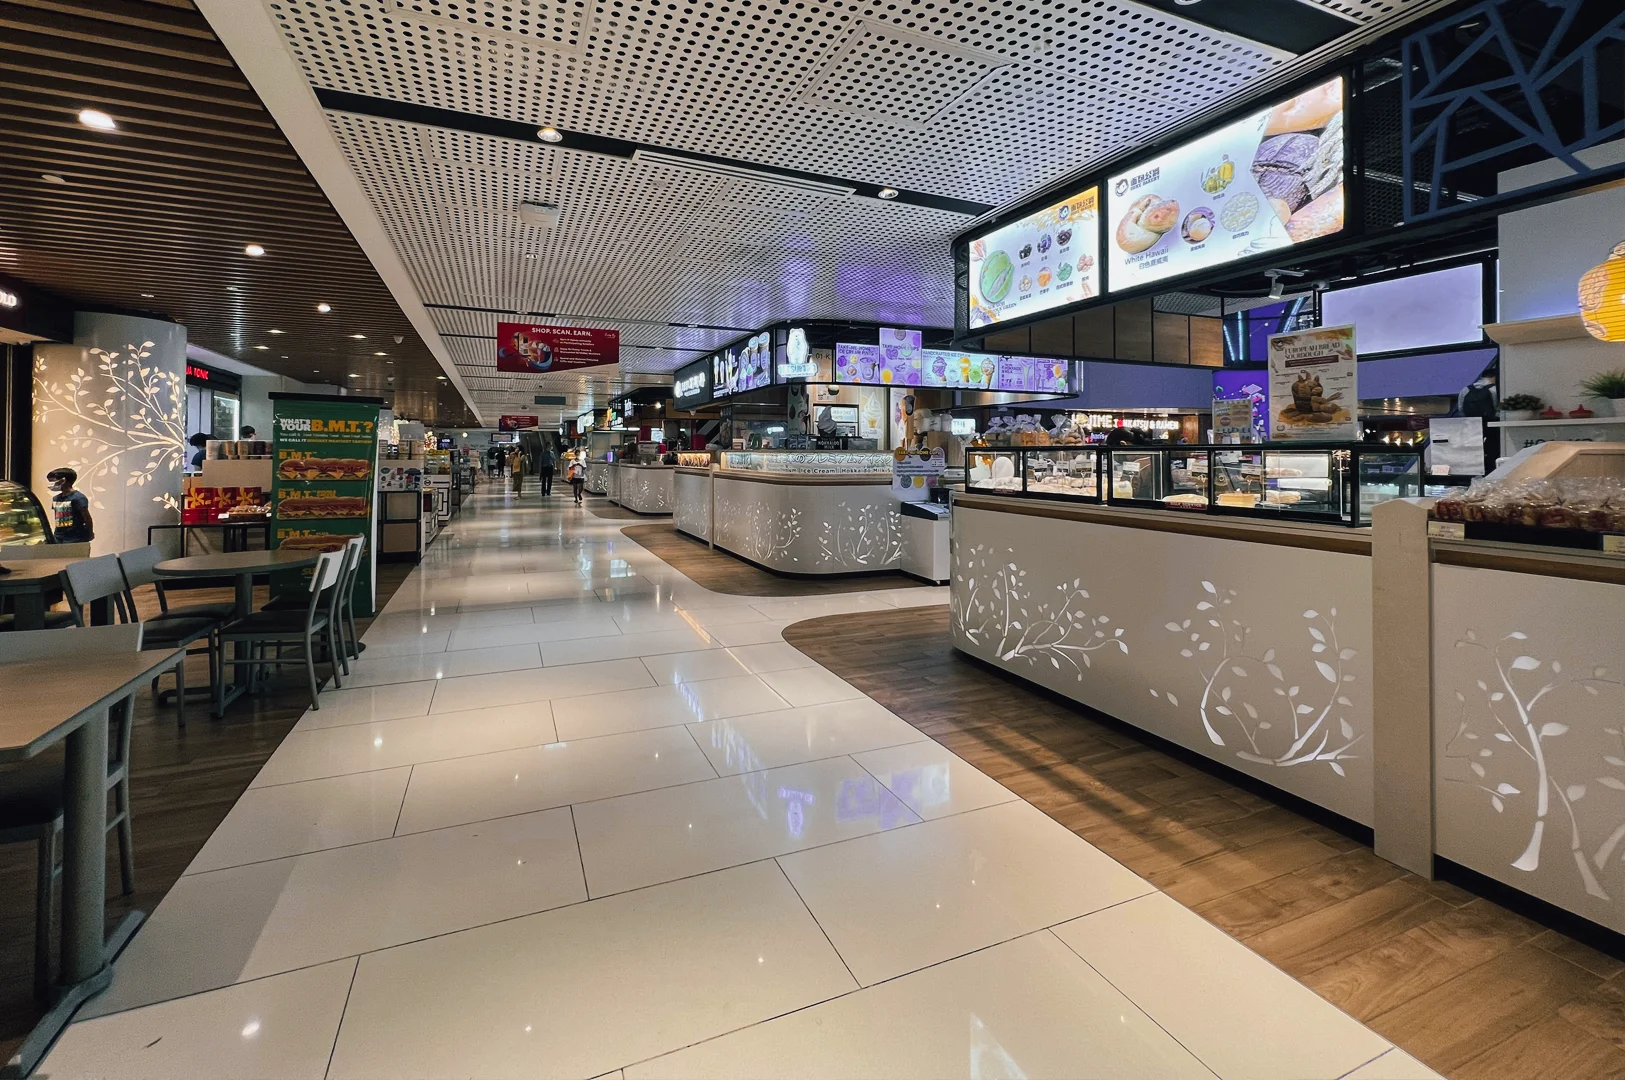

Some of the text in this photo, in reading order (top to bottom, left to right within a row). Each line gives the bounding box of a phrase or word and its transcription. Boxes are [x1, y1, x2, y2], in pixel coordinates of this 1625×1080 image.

[1124, 246, 1169, 265] White Hawaii
[1285, 342, 1340, 354] EUROPEAN BREAD
[1071, 412, 1113, 430] HJIME
[1150, 421, 1156, 429] &
[1156, 421, 1179, 430] RAMEN
